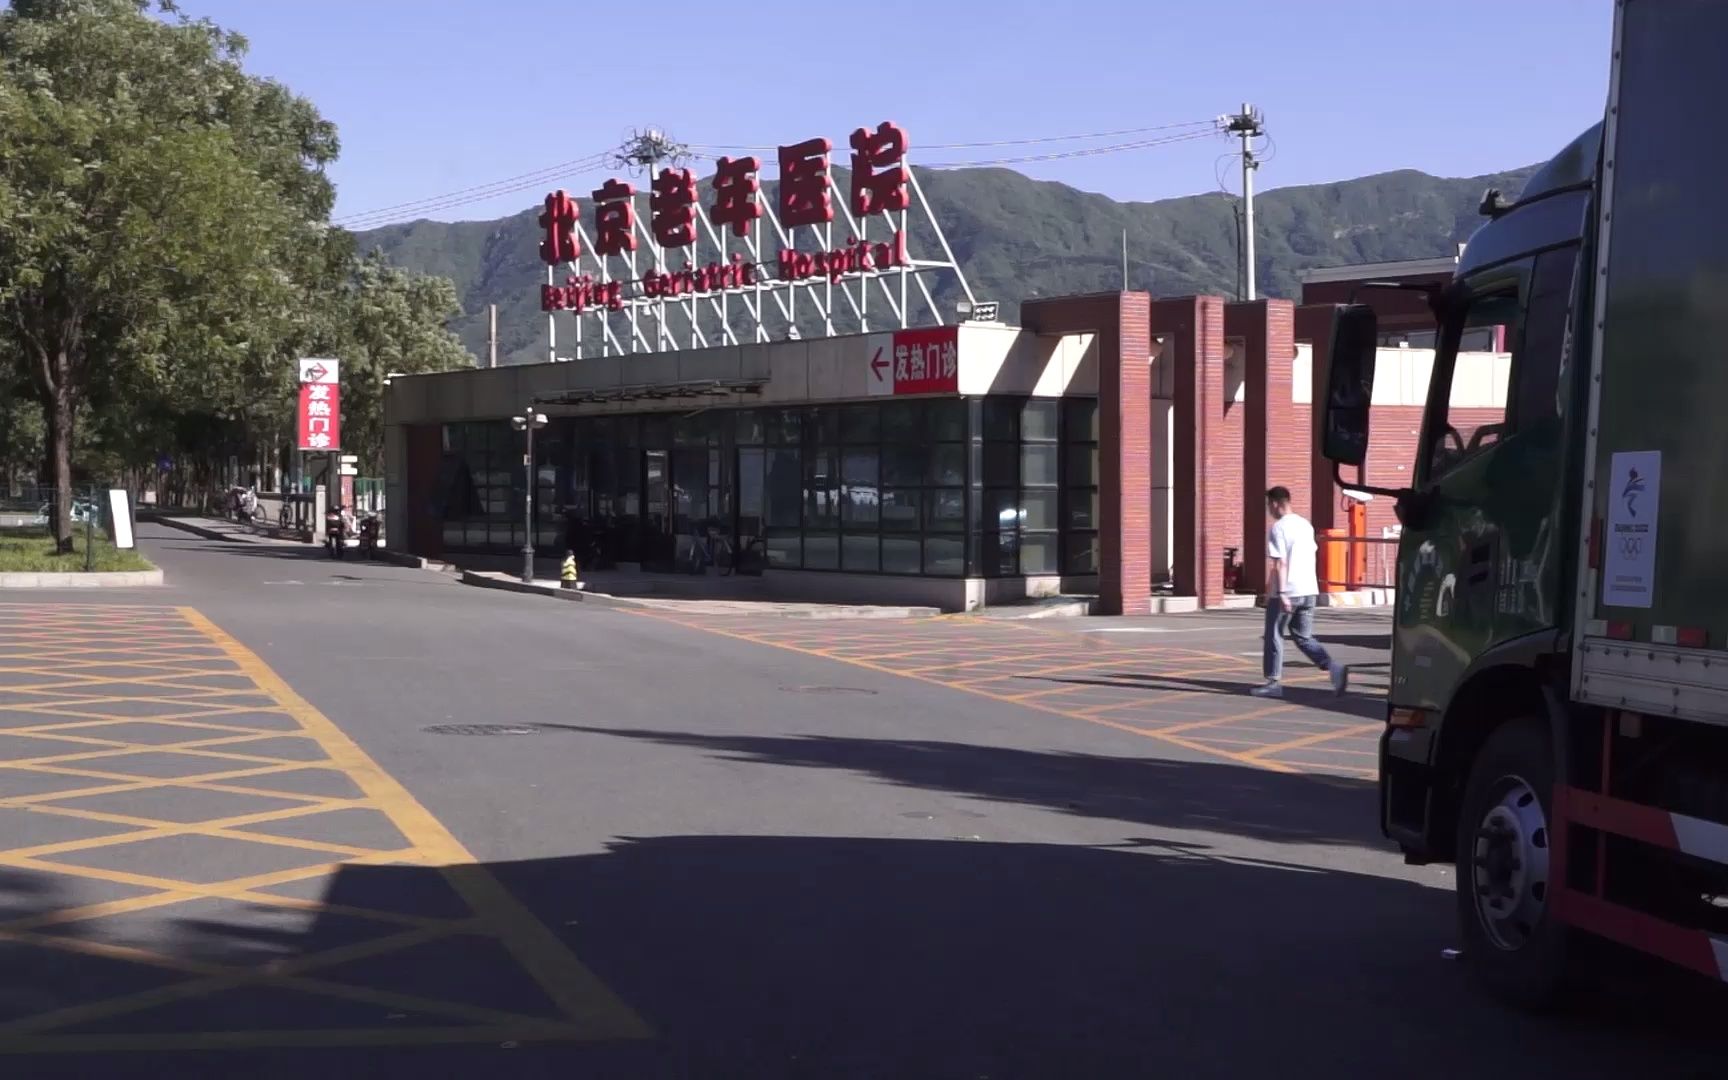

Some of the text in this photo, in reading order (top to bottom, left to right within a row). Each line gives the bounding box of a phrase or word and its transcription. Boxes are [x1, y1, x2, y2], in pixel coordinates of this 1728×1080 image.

[539, 121, 910, 265] 北京老年医院
[778, 230, 906, 284] Hospital
[896, 341, 957, 381] 发热门诊
[307, 385, 332, 448] 发热门诊
